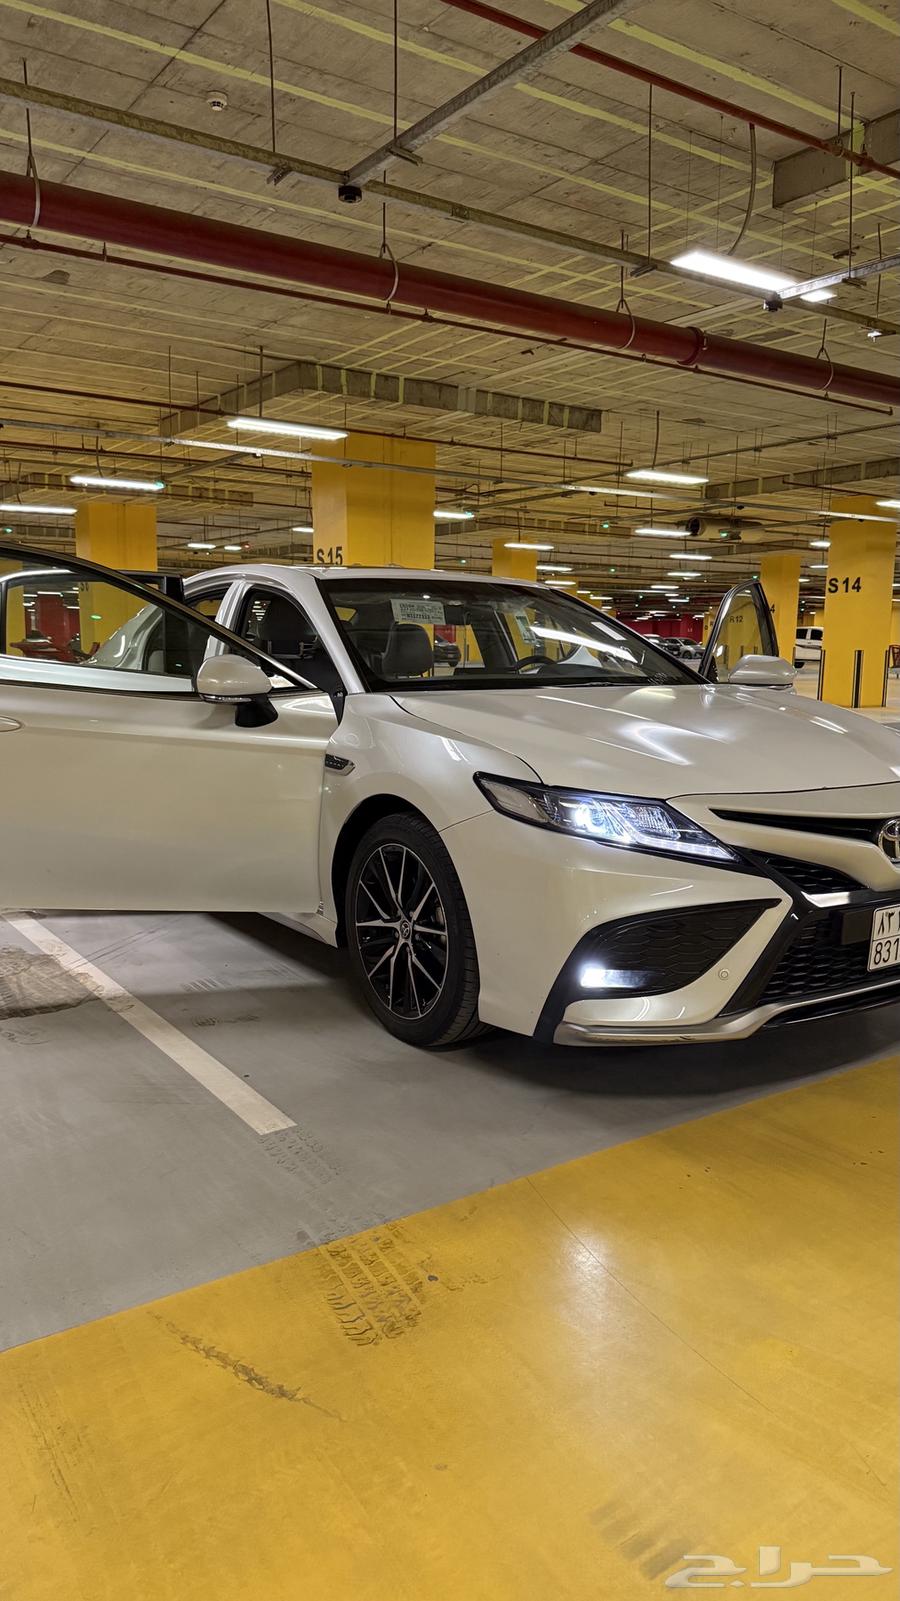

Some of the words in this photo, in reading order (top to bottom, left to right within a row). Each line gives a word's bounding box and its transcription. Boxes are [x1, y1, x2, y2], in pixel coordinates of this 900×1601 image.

[317, 546, 343, 565] S15
[828, 576, 862, 594] S14
[729, 615, 744, 624] R12
[873, 938, 899, 965] 831
